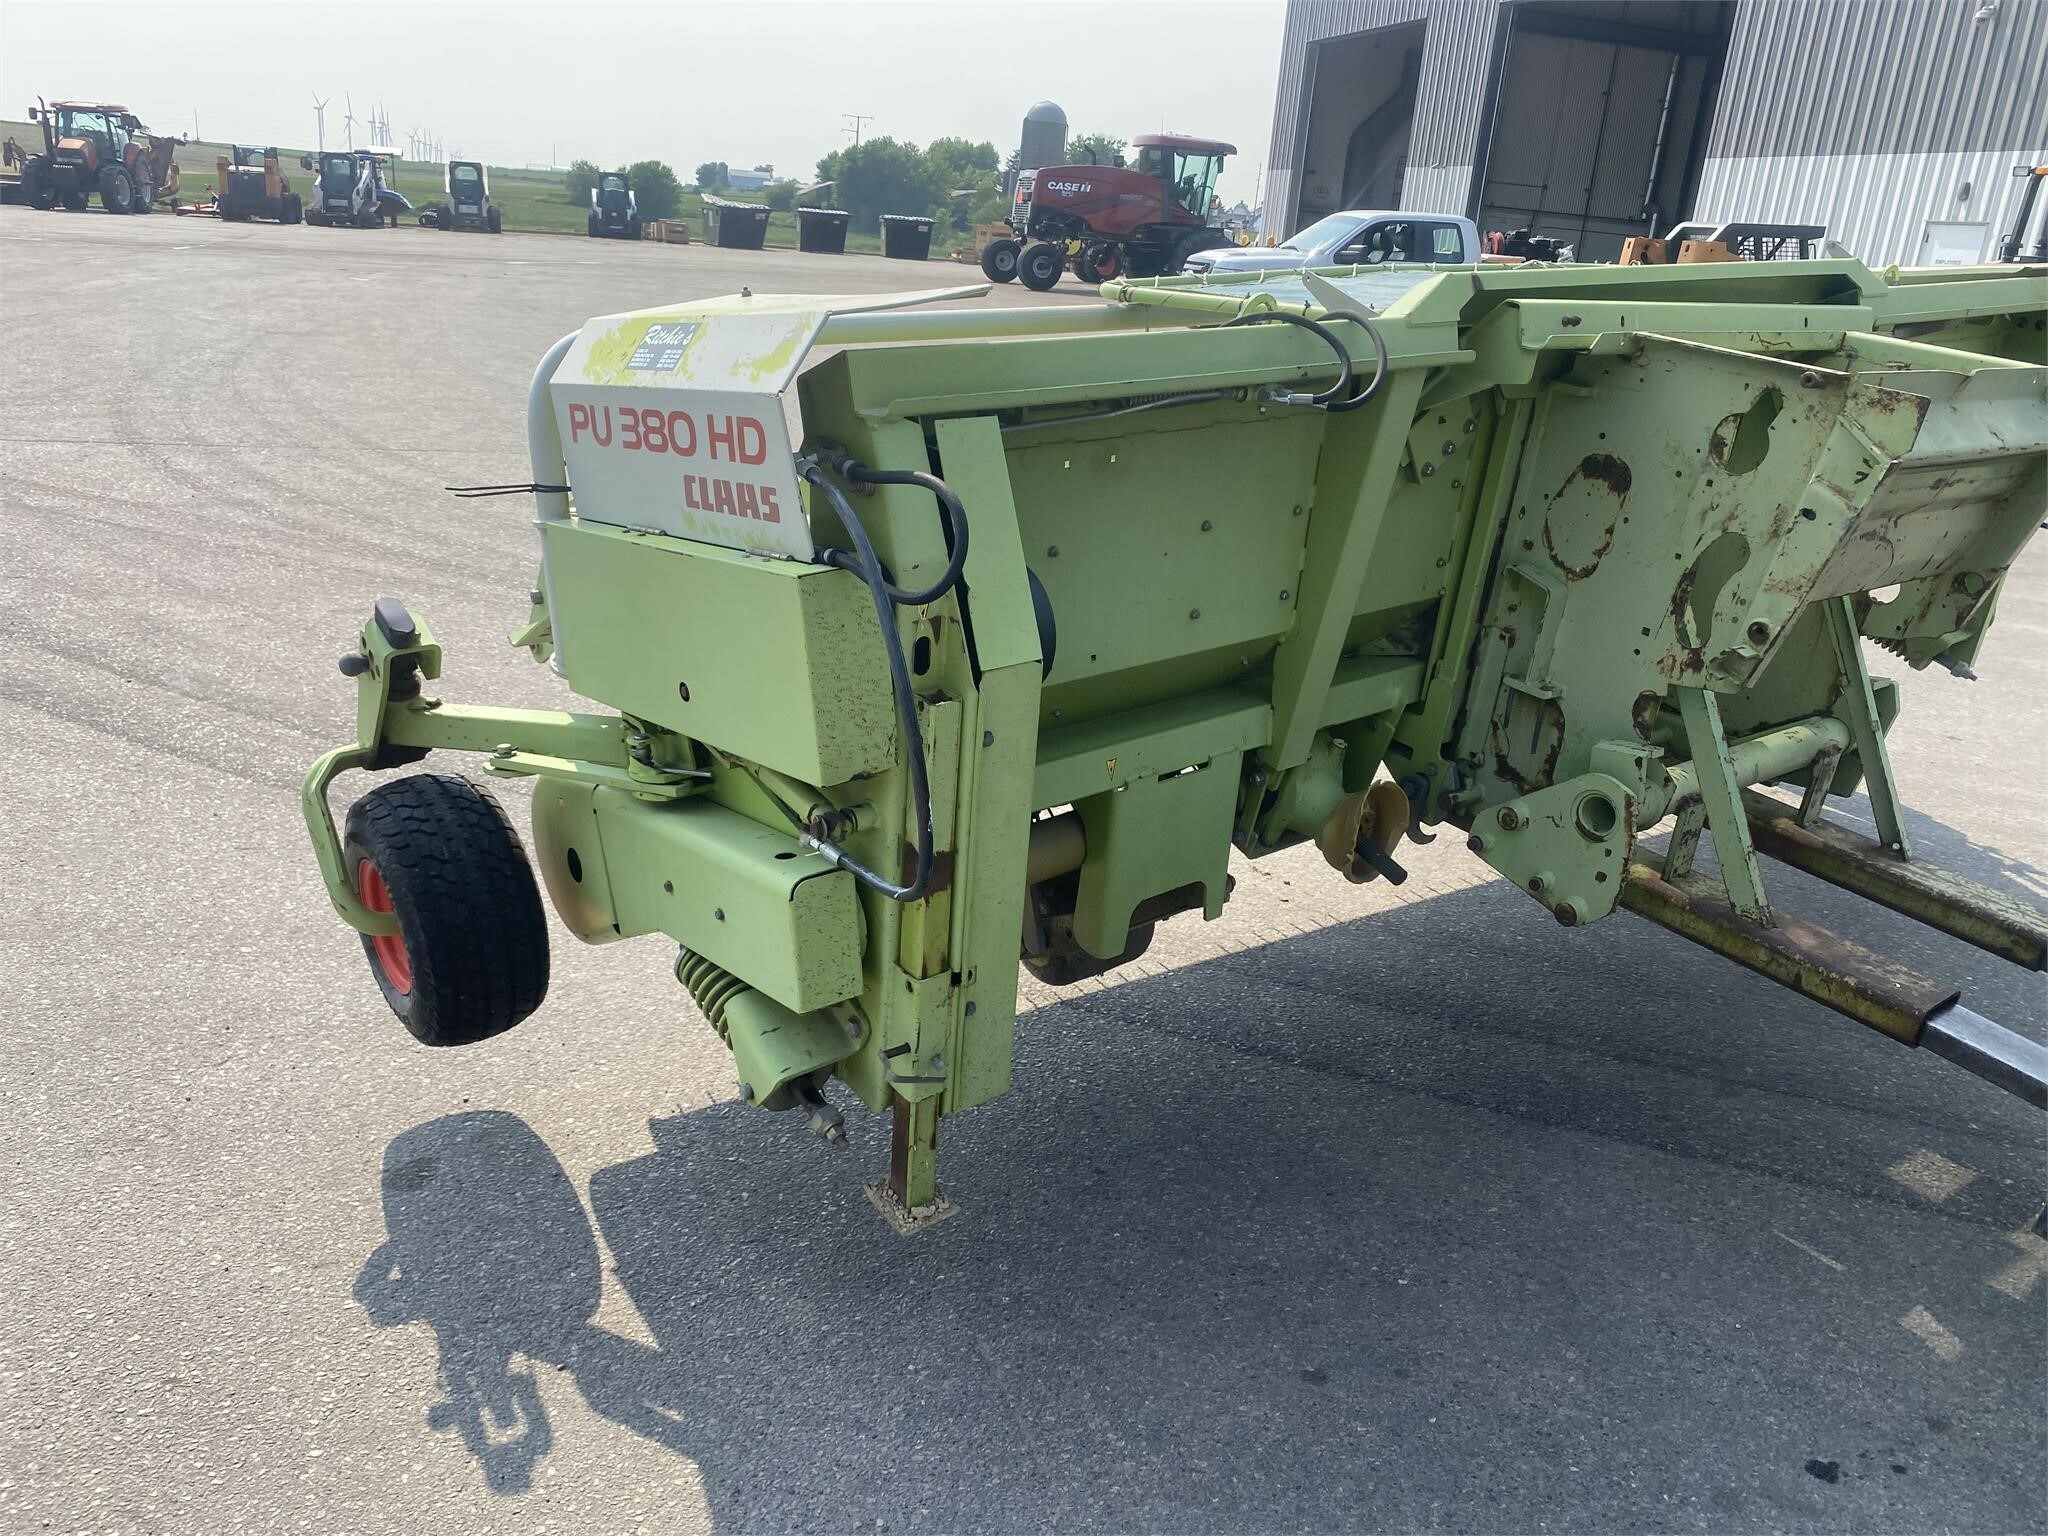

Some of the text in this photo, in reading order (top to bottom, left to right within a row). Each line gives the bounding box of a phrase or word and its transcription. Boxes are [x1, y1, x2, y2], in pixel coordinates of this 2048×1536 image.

[1047, 181, 1080, 192] CASE
[639, 325, 695, 346] Ritchie's
[569, 403, 766, 465] PU 380 HD
[684, 475, 780, 523] CLAAS
